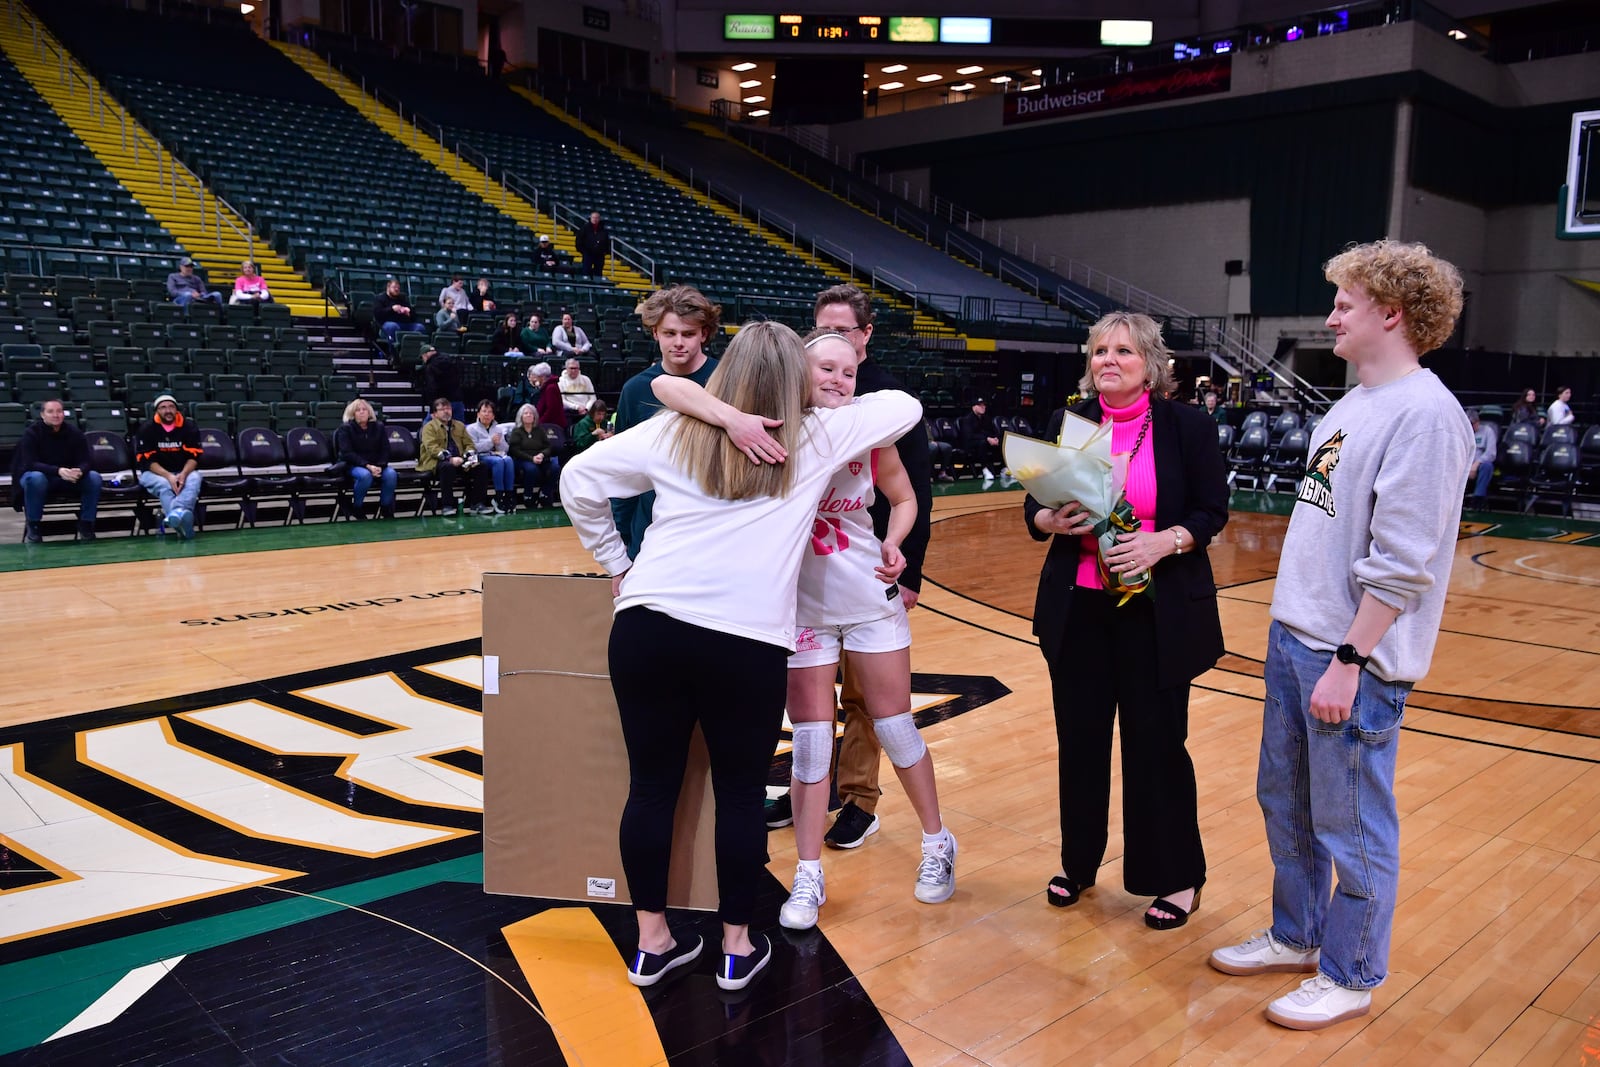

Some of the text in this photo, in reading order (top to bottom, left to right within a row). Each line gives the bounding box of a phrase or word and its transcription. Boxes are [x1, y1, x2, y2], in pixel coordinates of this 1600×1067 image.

[791, 25, 799, 37] 0
[818, 27, 842, 38] 11:39
[870, 27, 878, 38] 0
[1016, 88, 1105, 115] Budweiser
[818, 487, 865, 512] ders
[180, 589, 482, 626] ton children's
